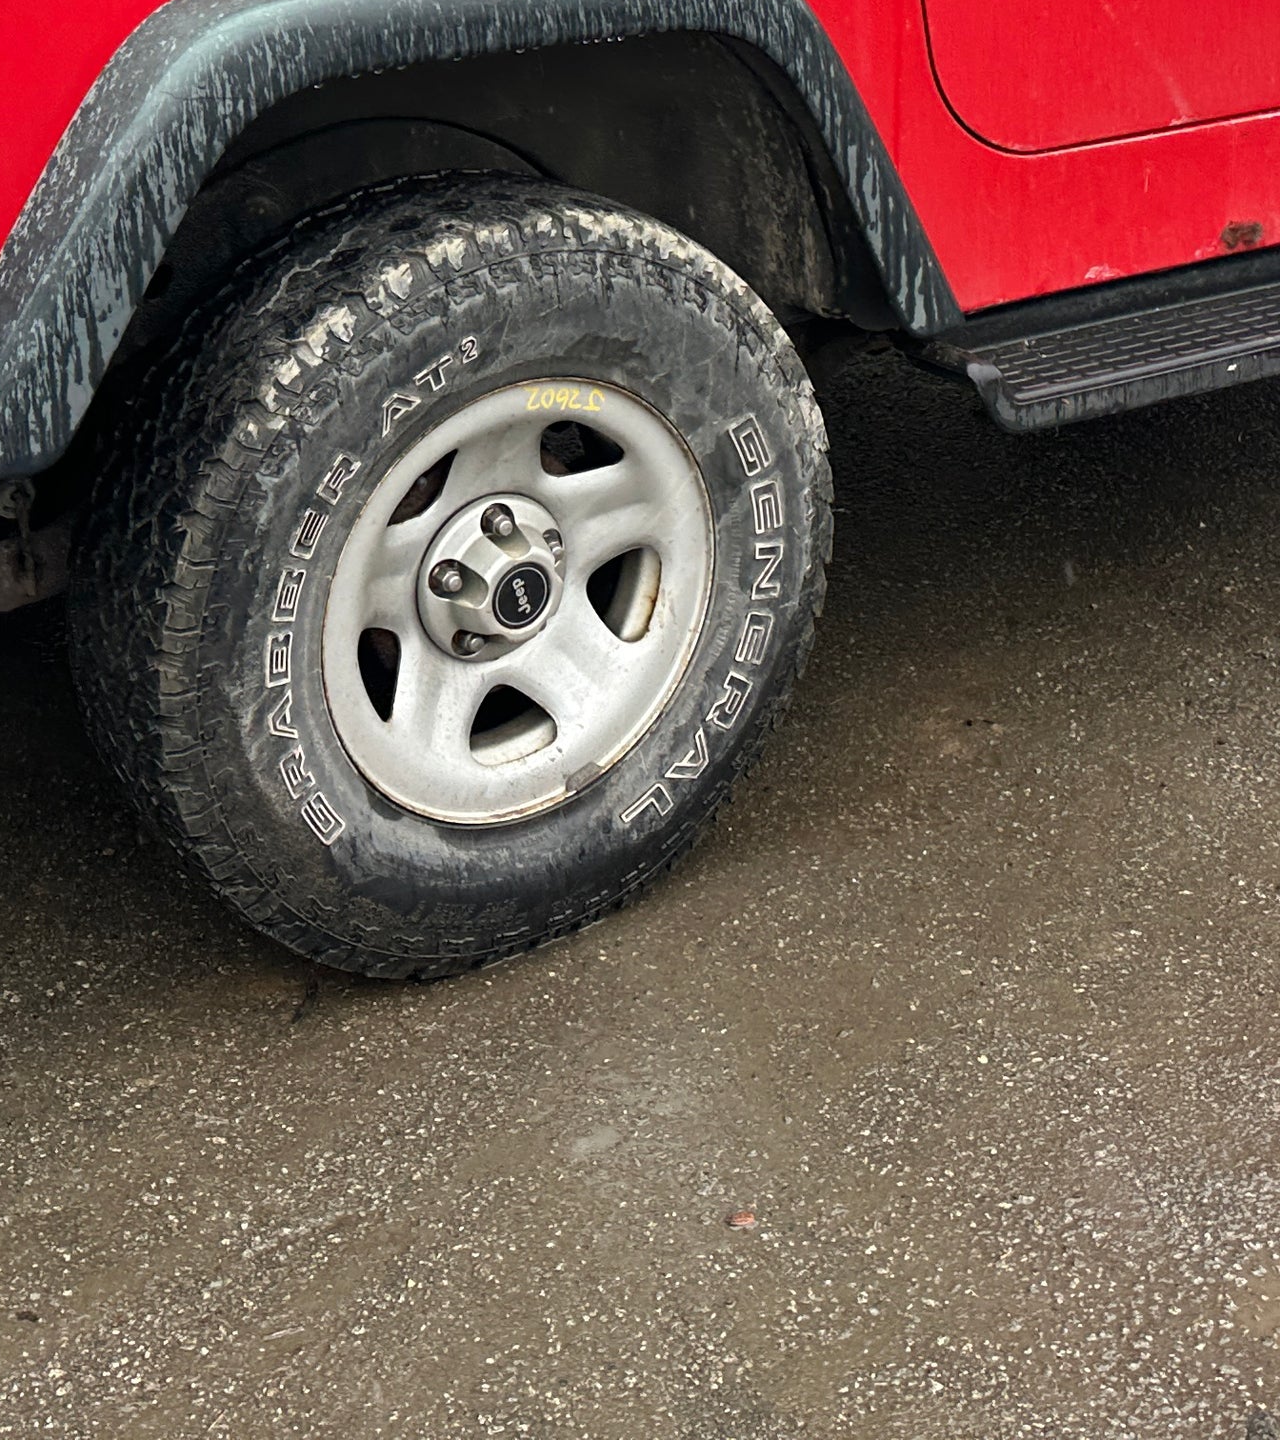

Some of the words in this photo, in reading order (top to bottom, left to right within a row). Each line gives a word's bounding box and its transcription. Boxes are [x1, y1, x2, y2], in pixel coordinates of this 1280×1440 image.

[523, 386, 605, 411] J2602
[265, 453, 361, 846] GRABBER
[512, 577, 531, 614] Jeep
[620, 414, 786, 826] GENERAL
